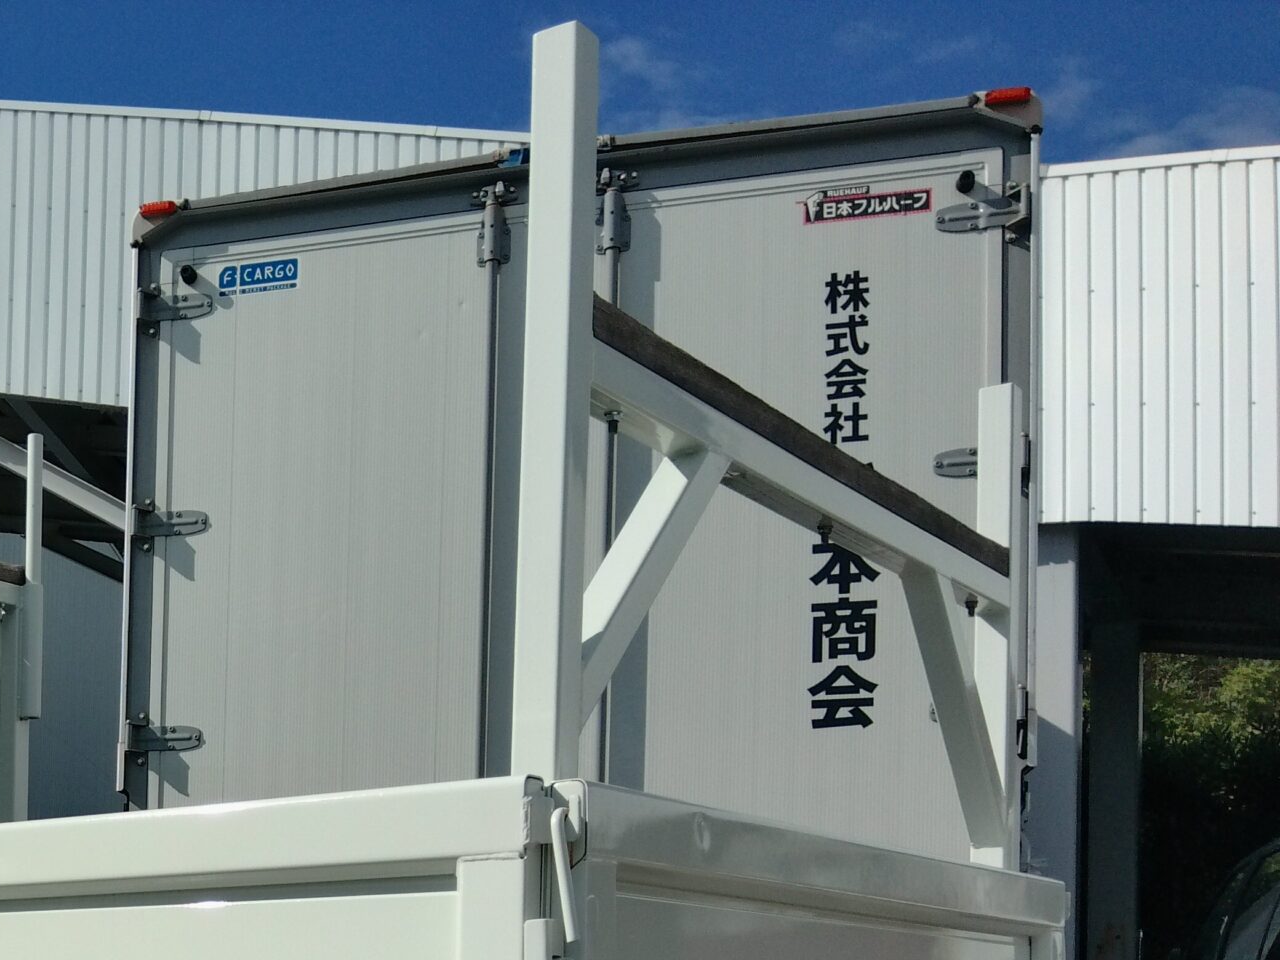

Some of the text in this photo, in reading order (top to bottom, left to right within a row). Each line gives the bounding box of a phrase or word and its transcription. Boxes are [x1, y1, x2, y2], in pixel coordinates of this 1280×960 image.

[822, 192, 928, 219] 日本フルハーフ
